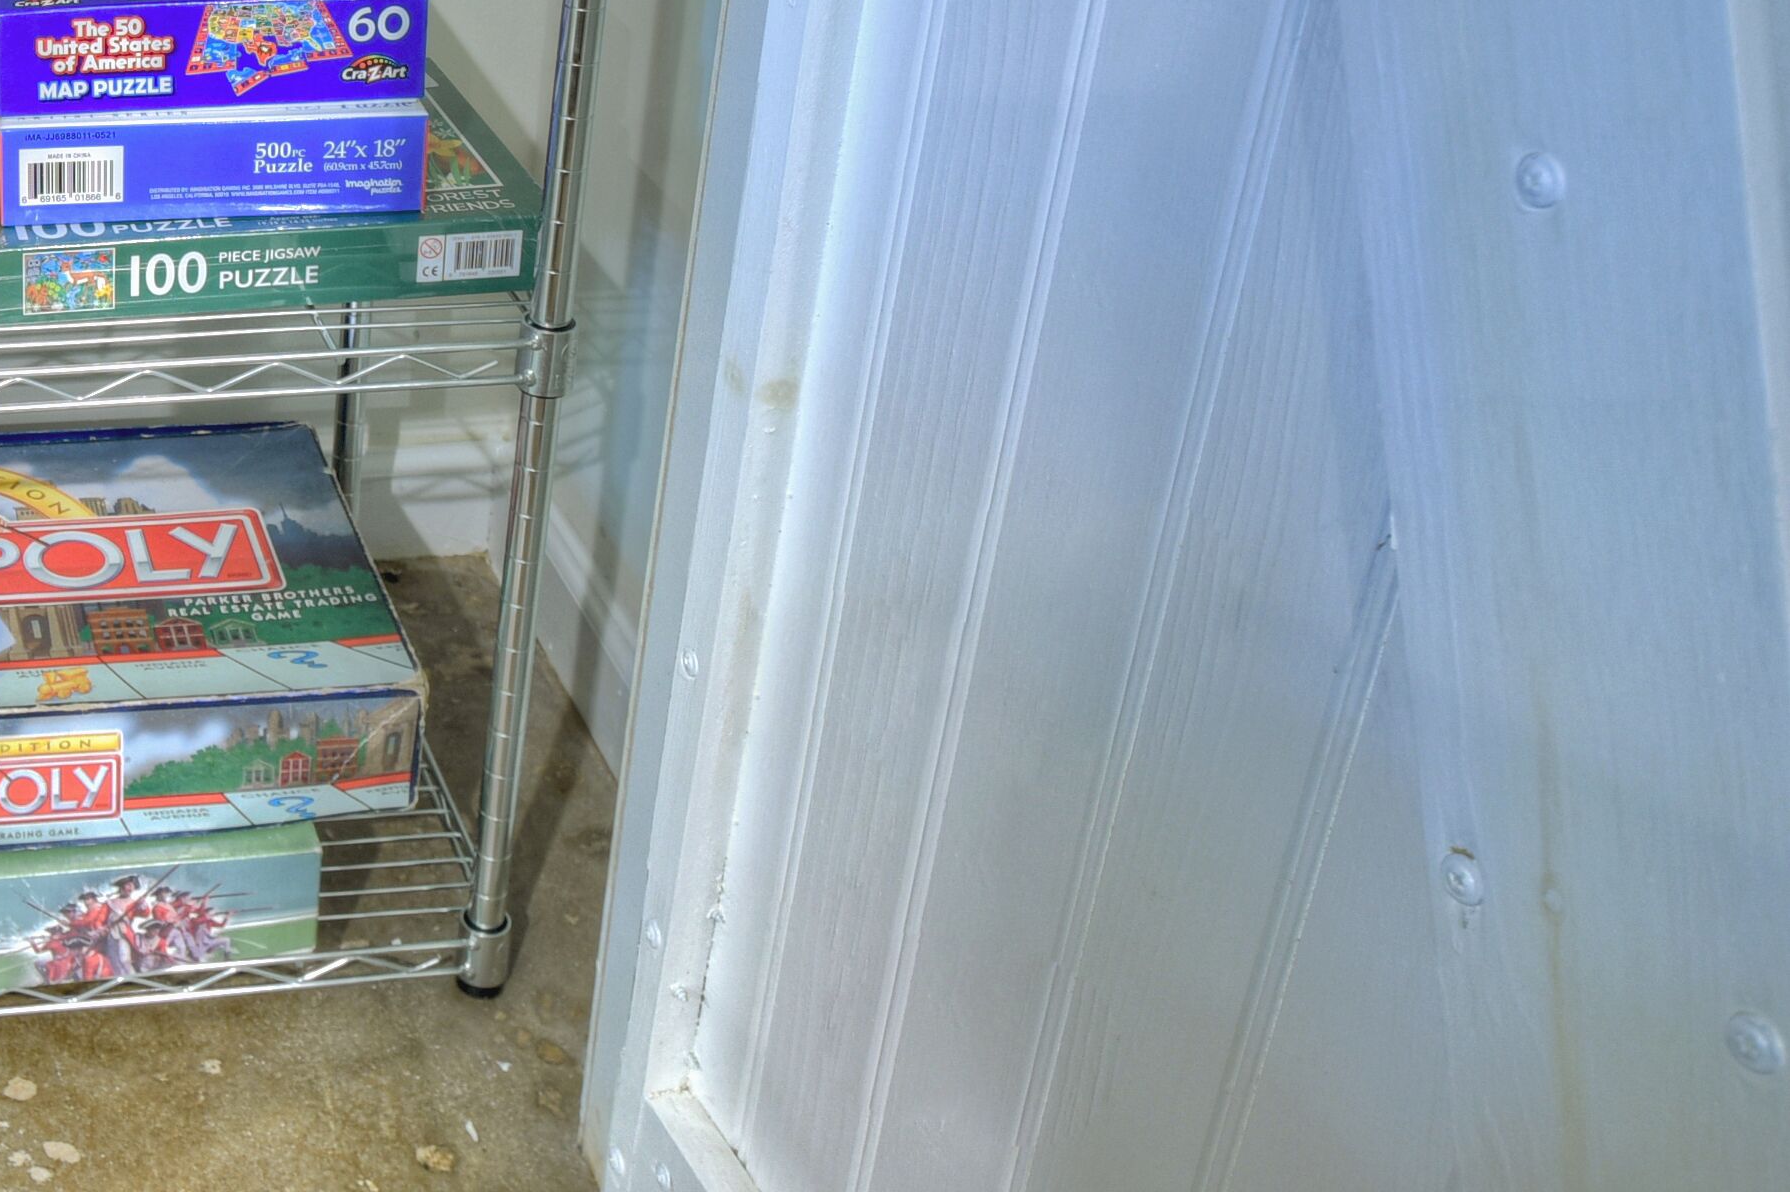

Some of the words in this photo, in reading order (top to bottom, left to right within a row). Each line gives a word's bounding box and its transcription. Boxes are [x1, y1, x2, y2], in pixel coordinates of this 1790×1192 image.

[73, 20, 110, 38] The
[115, 18, 142, 36] 50
[348, 5, 410, 42] 60
[37, 37, 104, 57] United
[109, 36, 172, 54] States
[53, 56, 77, 73] of
[83, 53, 163, 72] America
[39, 81, 90, 100] MAP
[93, 76, 173, 98] PUZZLE
[255, 142, 291, 158] 500
[292, 148, 306, 158] PC
[253, 159, 313, 174] Puzzle
[21, 196, 28, 204] 6
[39, 194, 67, 203] 69165
[74, 193, 102, 202] 01866
[115, 192, 122, 200] 6
[426, 189, 501, 202] OREST
[424, 199, 515, 213] RIENDS
[111, 217, 233, 234] PUZZLE
[130, 251, 208, 297] 100
[218, 251, 261, 263] PIECE
[263, 246, 321, 262] JIGSAW
[218, 265, 320, 290] PUZZLE
[184, 594, 253, 607] PARKER
[263, 586, 355, 602] BROTHERS
[168, 606, 210, 618] REAL
[220, 599, 284, 614] ESTATE
[294, 593, 378, 608] TRADING
[251, 609, 302, 621] GAME
[241, 787, 324, 799] CHANCE
[150, 812, 210, 820] AVENUE
[48, 827, 80, 837] GAME
